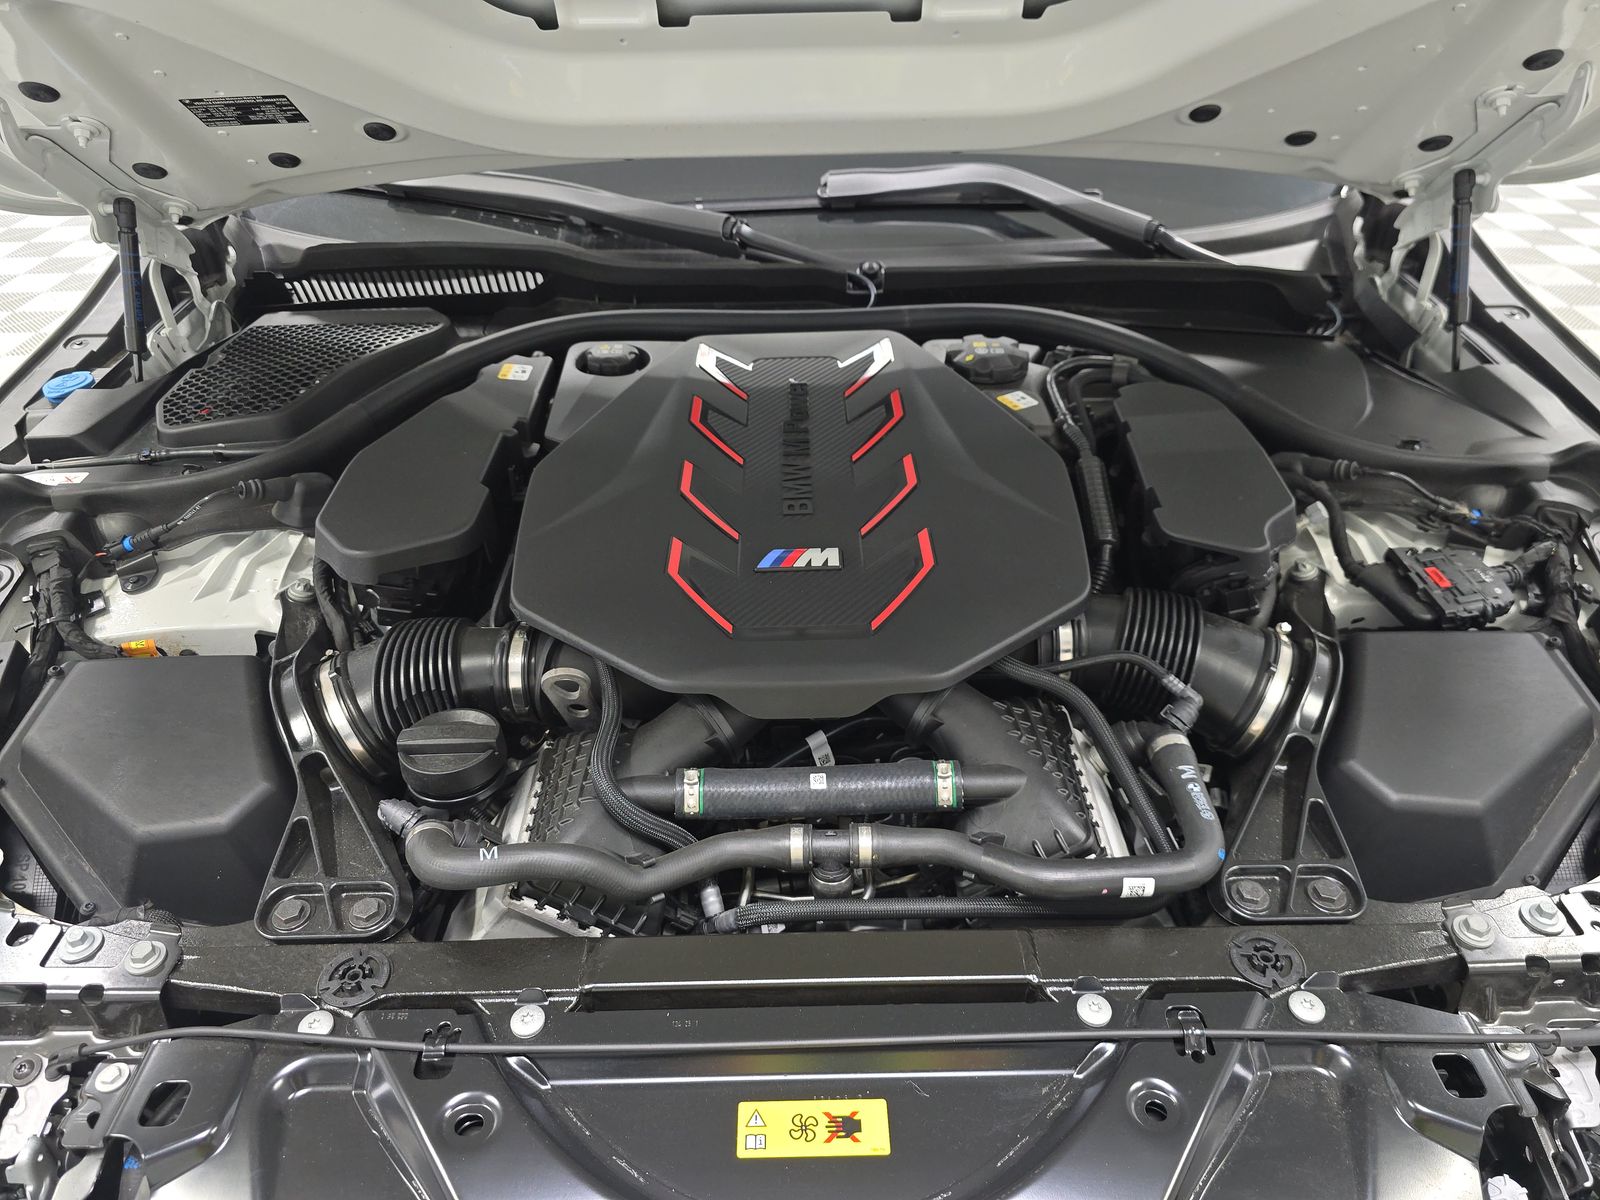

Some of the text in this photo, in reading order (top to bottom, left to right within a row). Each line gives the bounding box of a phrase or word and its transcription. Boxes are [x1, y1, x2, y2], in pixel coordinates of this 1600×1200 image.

[782, 462, 813, 516] BMW
[792, 547, 841, 568] M
[479, 845, 499, 861] M
